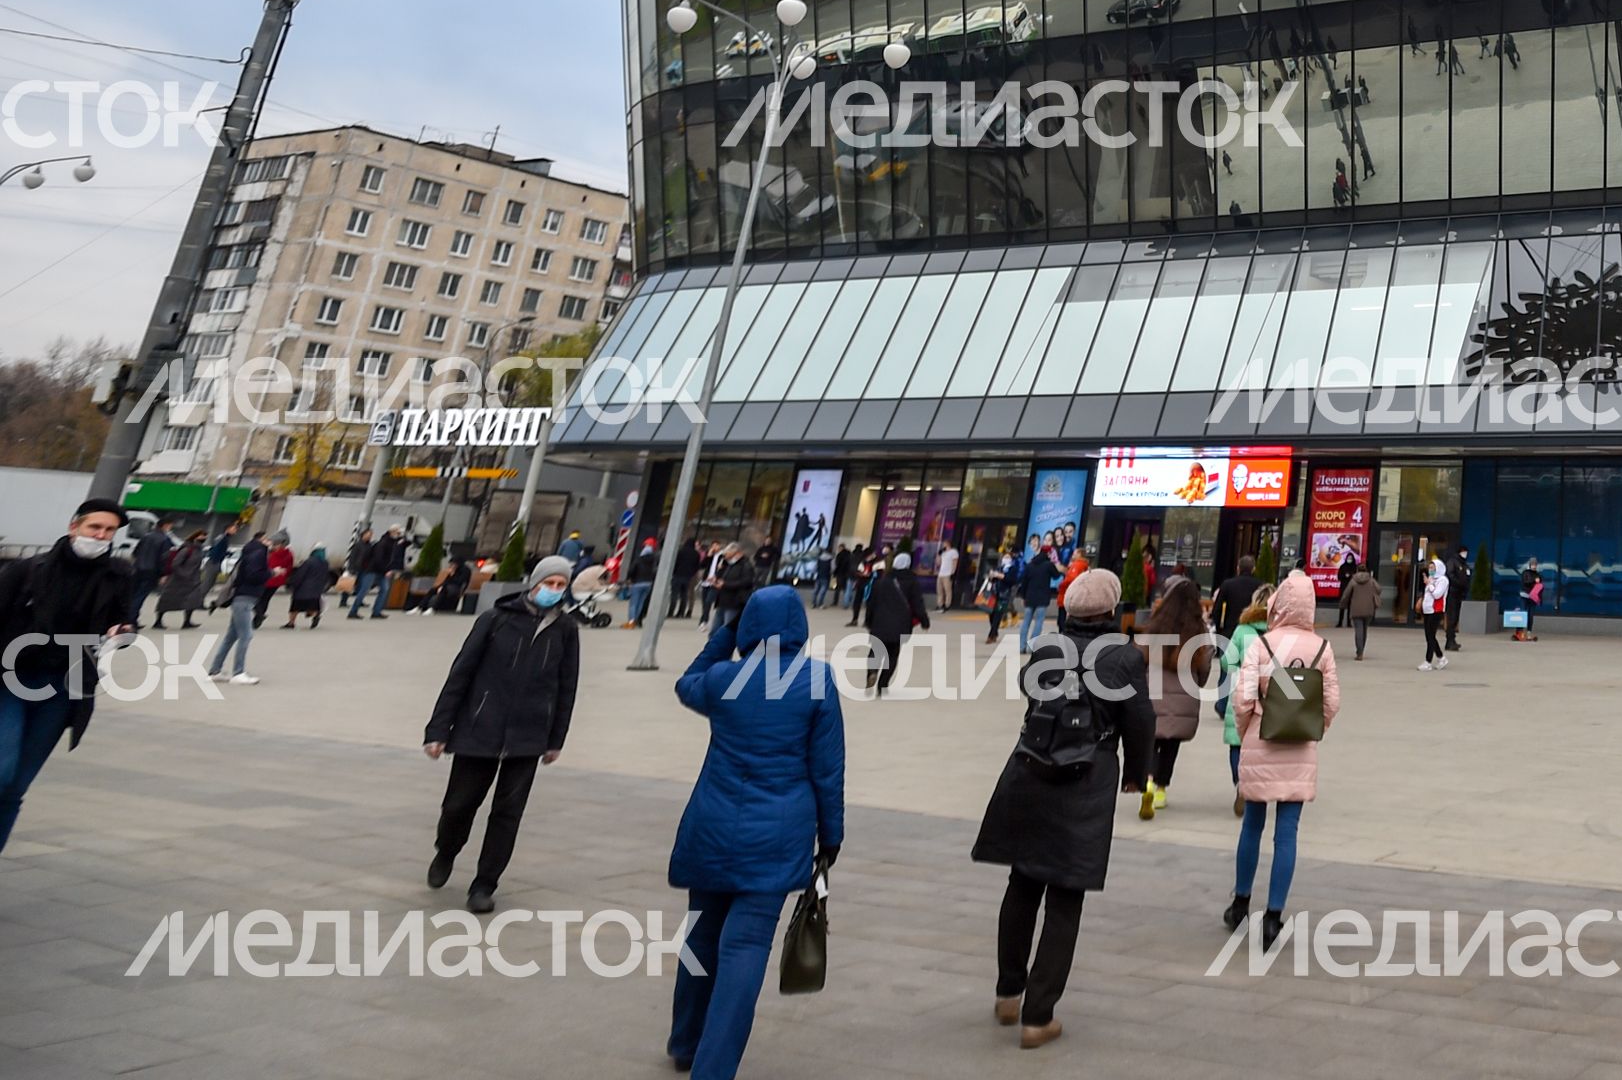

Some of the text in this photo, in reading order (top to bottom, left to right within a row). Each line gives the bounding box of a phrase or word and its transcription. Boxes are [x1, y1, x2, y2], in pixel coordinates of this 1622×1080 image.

[393, 407, 552, 447] ПАРКИНГ
[1246, 471, 1283, 488] KFC
[1315, 474, 1370, 487] Леонардо
[1315, 511, 1346, 520] СКОРО
[1352, 506, 1362, 523] 4
